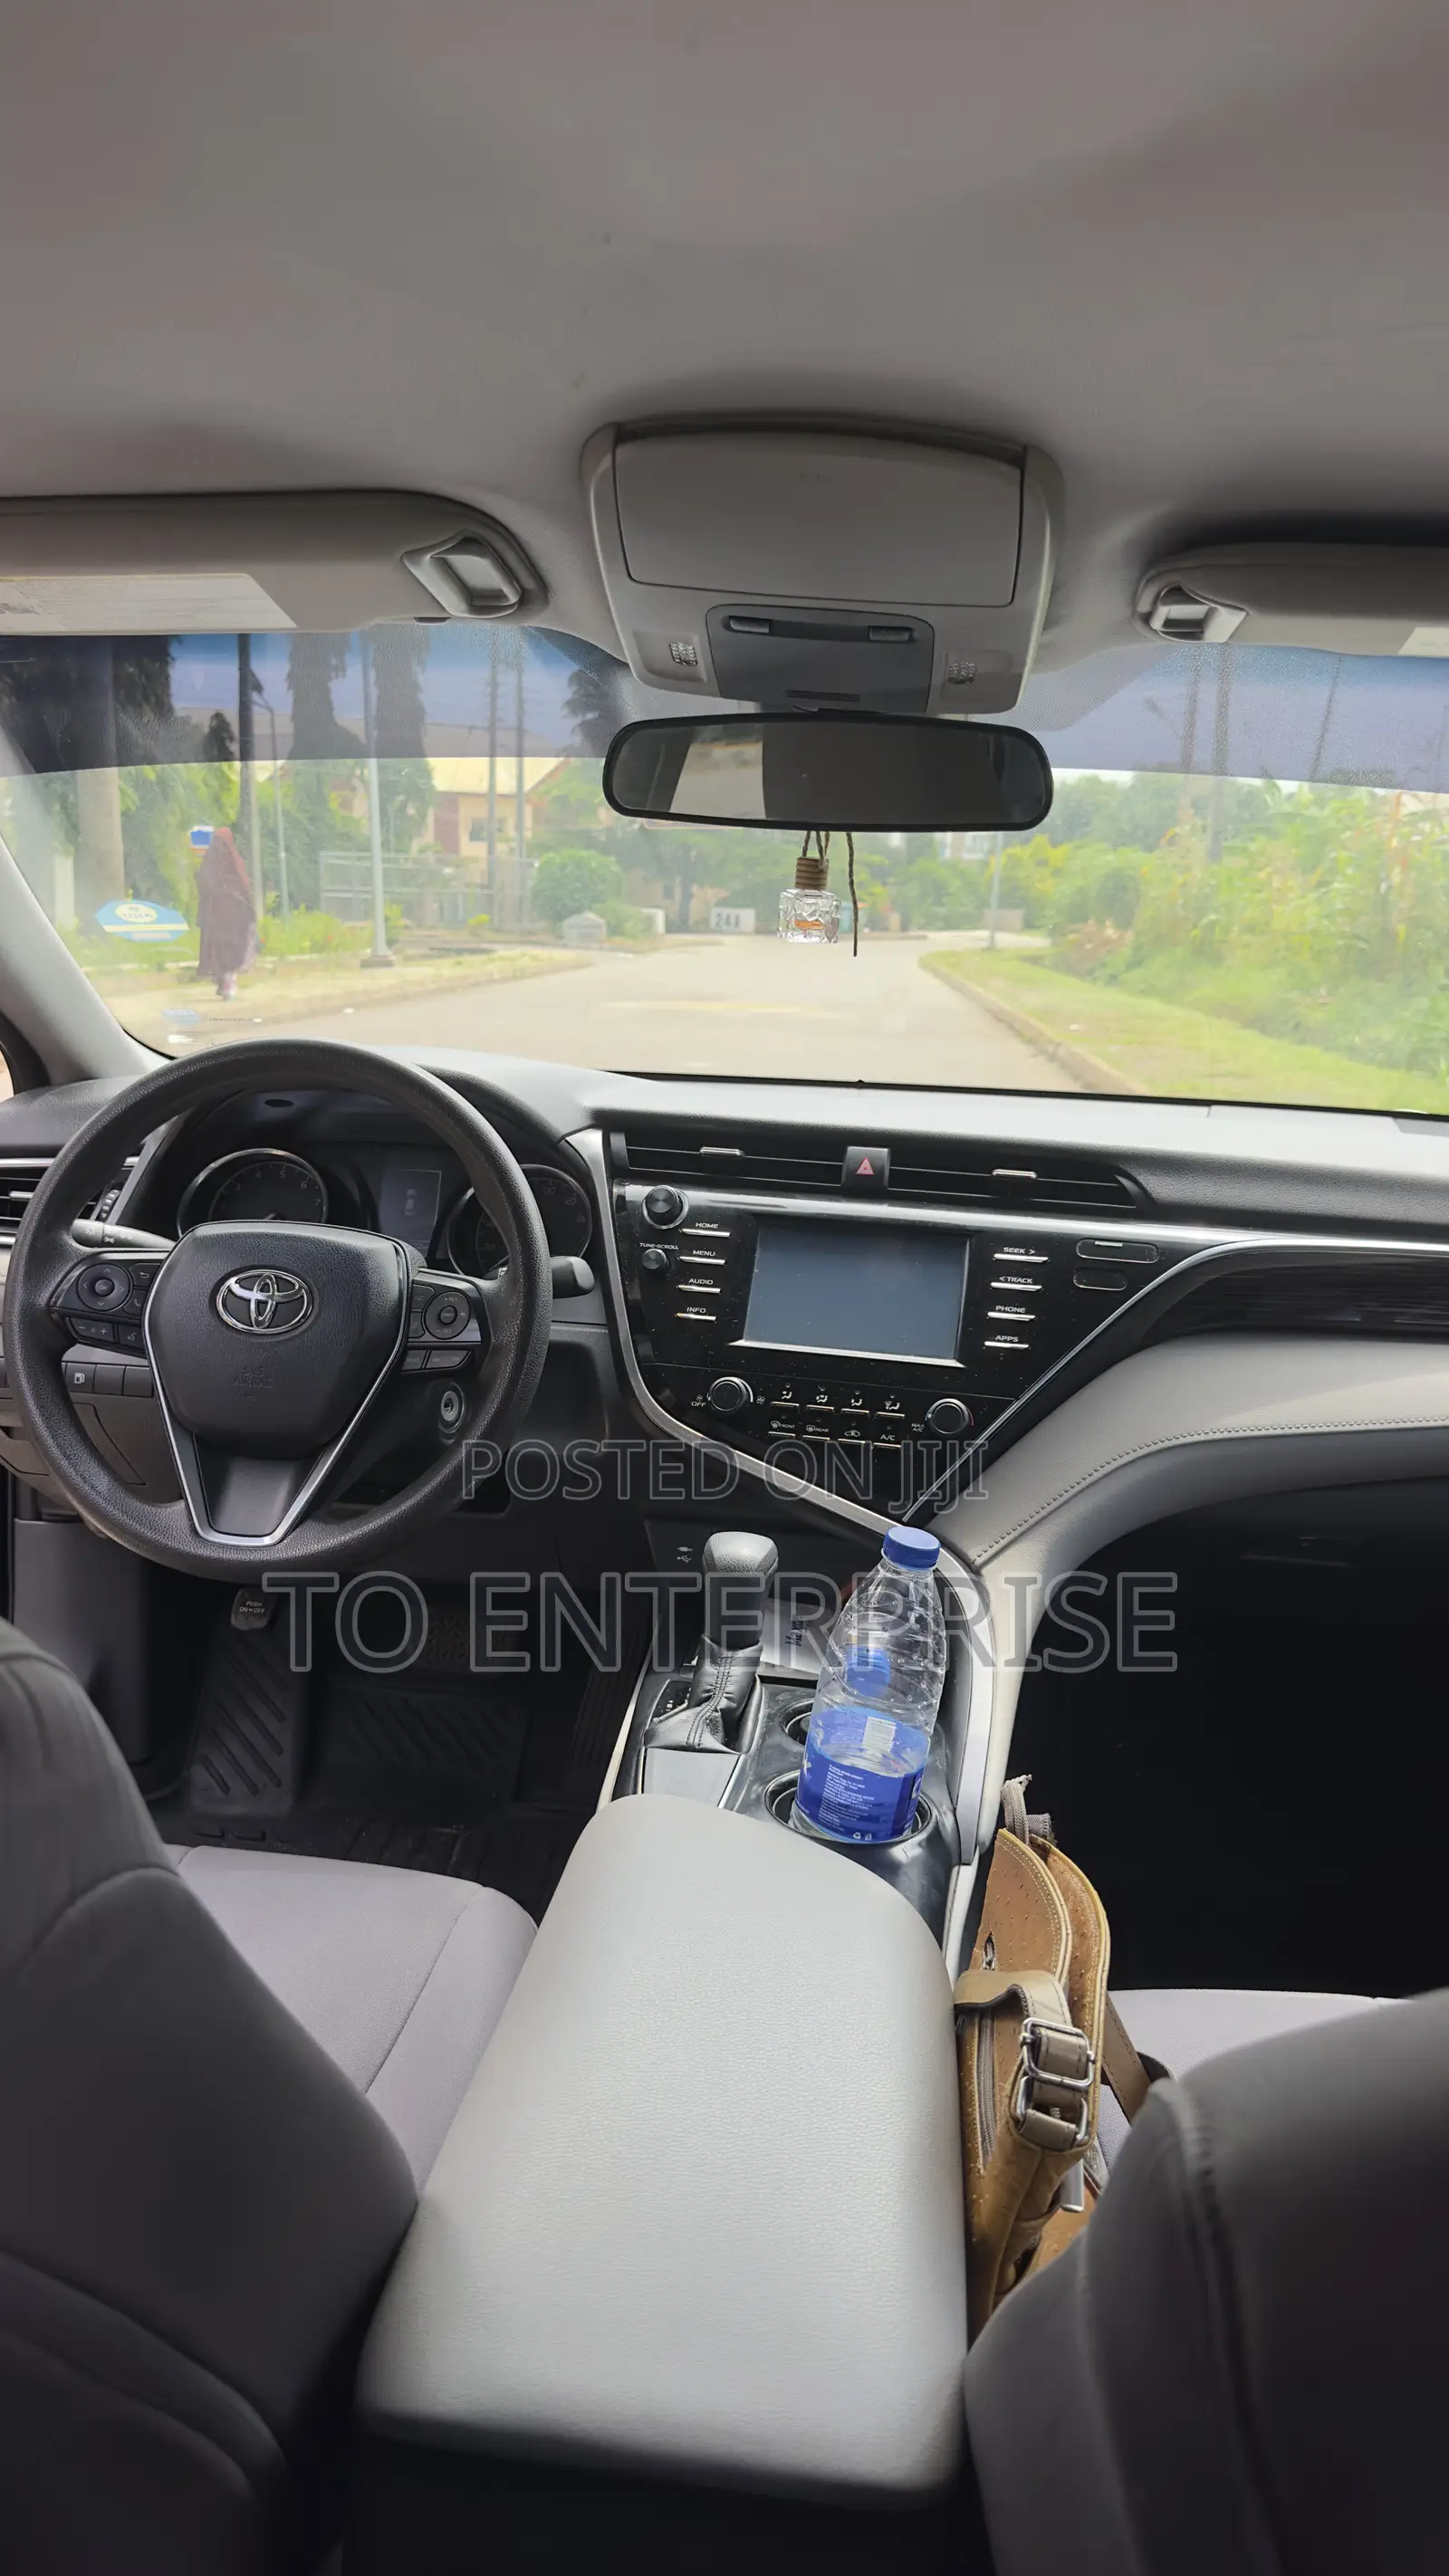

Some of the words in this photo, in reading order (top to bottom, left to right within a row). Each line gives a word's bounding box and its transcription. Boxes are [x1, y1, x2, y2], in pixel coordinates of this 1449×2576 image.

[301, 1181, 308, 1189] 6
[688, 1278, 714, 1286] AUDIO
[1006, 1276, 1033, 1284] TRACK
[995, 1305, 1026, 1314] PHONE
